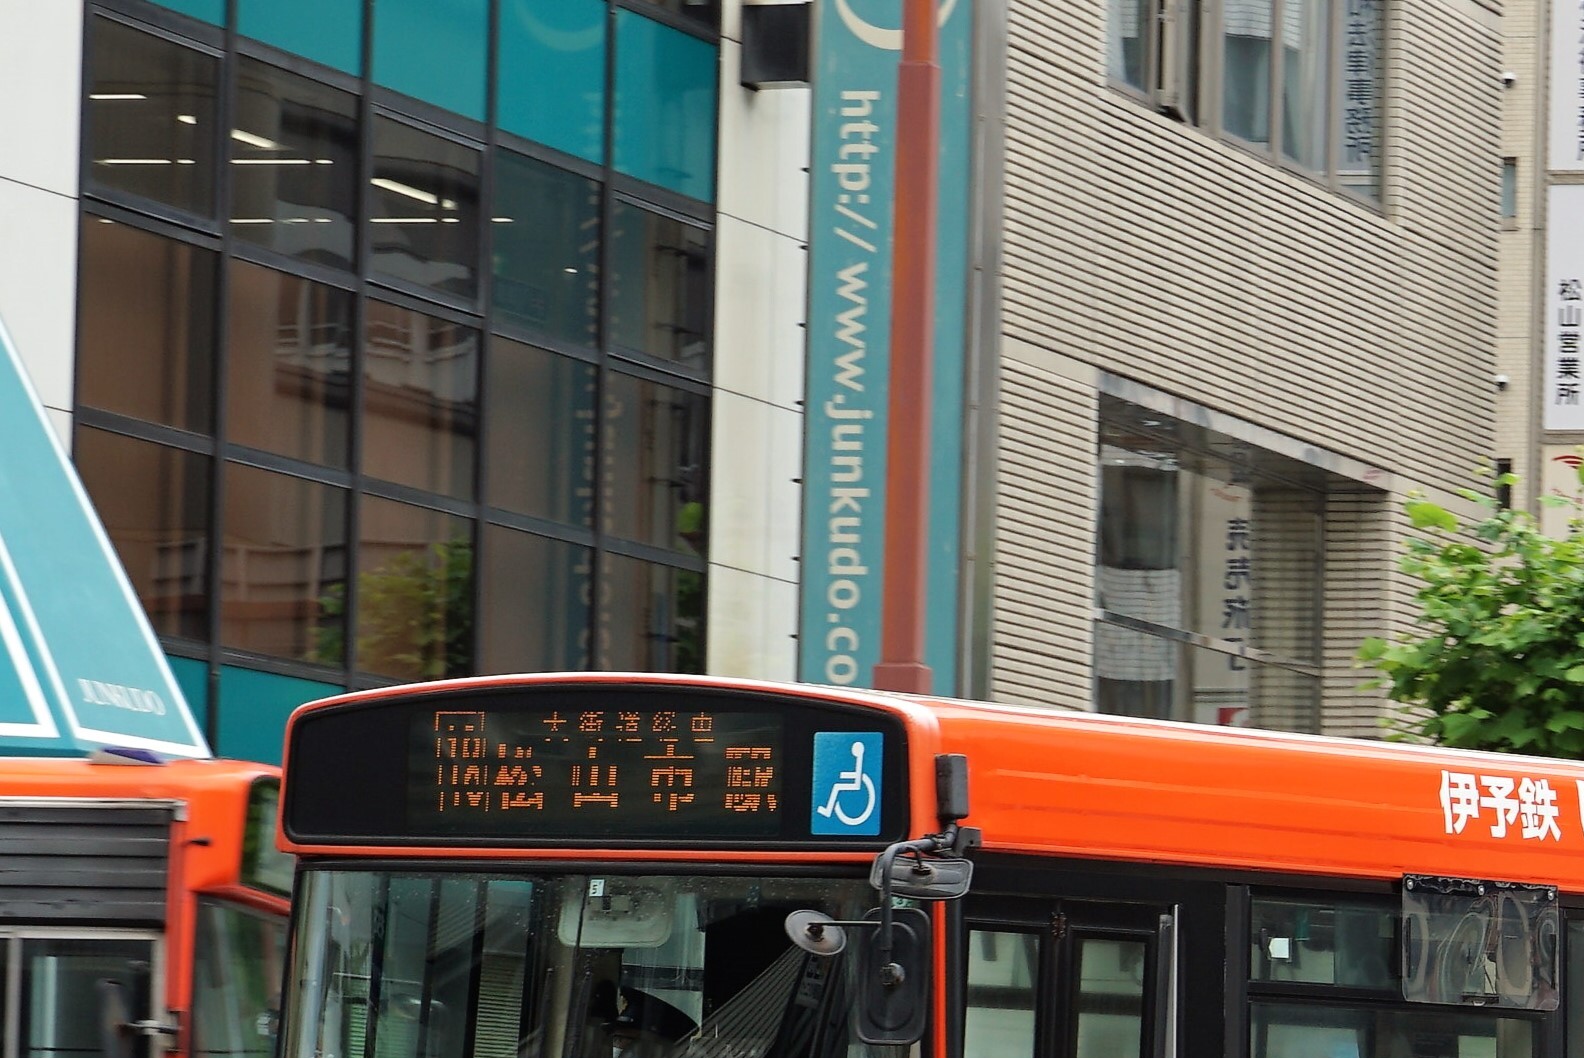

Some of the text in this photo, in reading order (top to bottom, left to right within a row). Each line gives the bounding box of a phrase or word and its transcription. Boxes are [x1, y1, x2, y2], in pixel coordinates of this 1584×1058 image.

[825, 90, 881, 685] http://www.junkudo.co
[1555, 279, 1583, 405] 松山営業所
[1439, 770, 1561, 842] 伊予鉄
